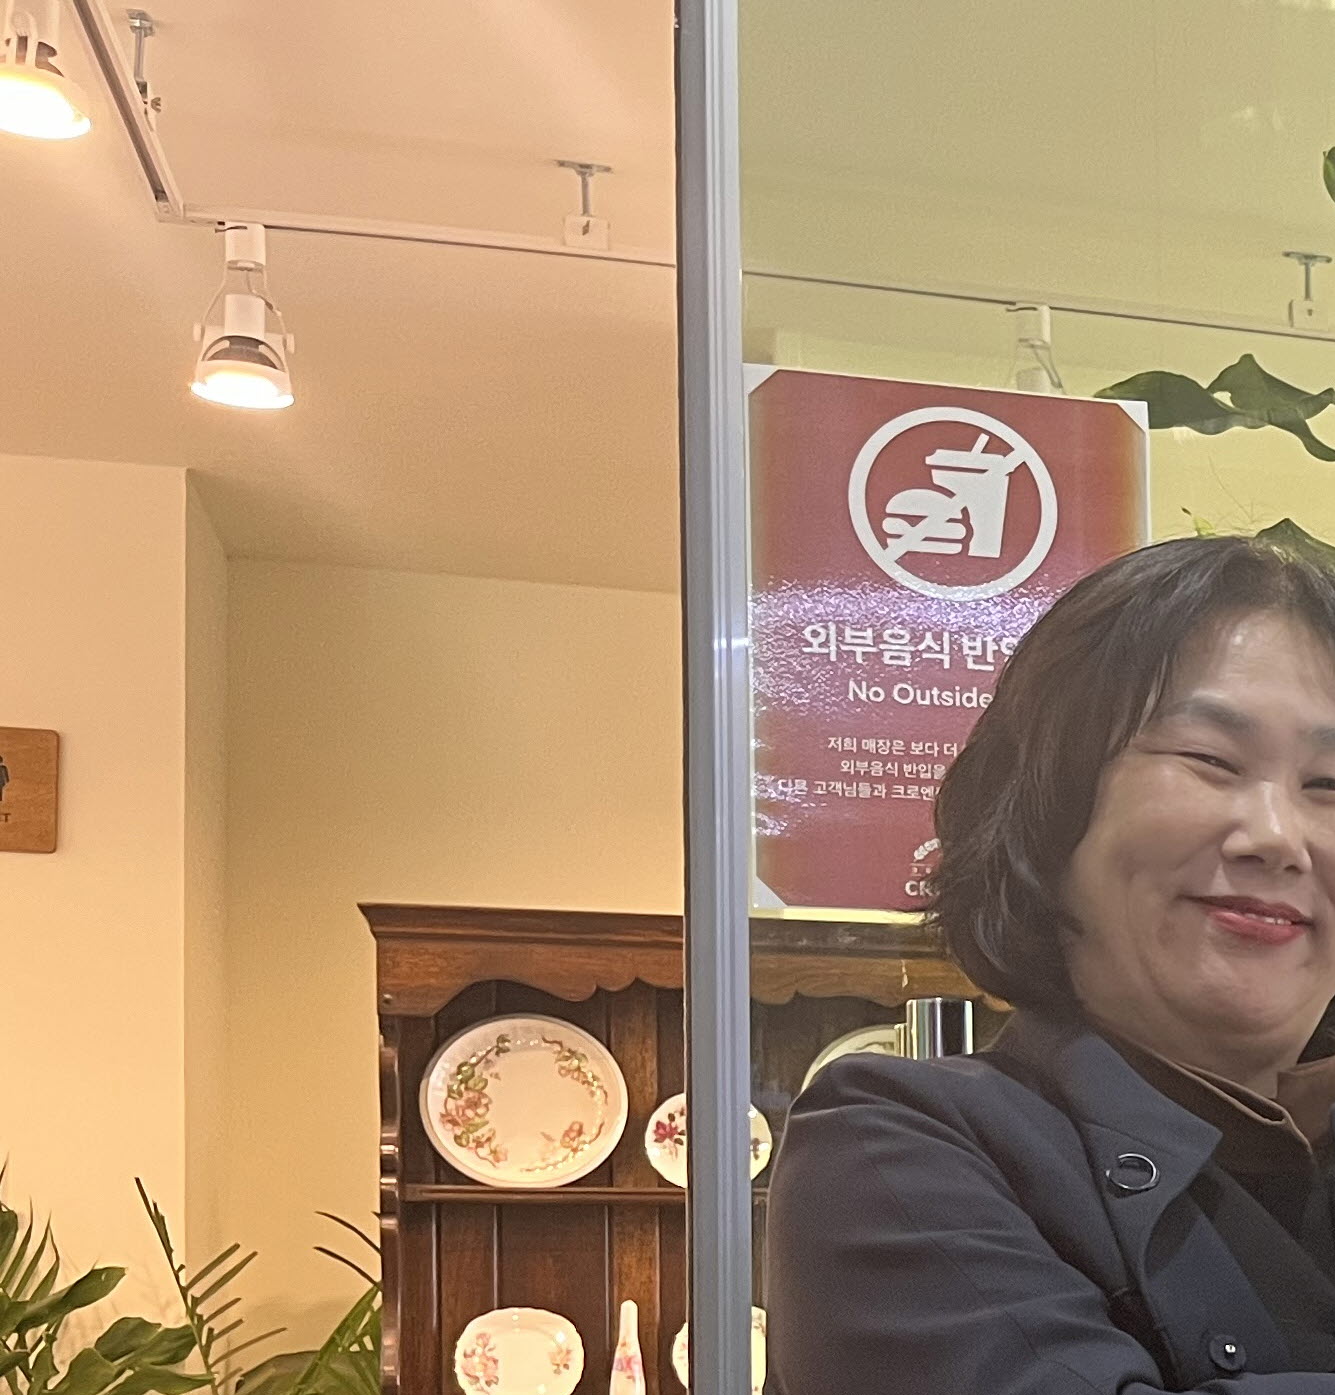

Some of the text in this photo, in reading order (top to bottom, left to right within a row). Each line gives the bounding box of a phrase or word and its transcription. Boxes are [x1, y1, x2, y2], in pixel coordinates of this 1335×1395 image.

[801, 622, 951, 669] 외부음식
[848, 680, 993, 708] No Outside
[827, 736, 958, 757] 저희 매장은 보다 더
[840, 759, 947, 779] 외부음식 반입을
[813, 779, 887, 798] 고객님들과
[891, 783, 940, 801] 크로엔
